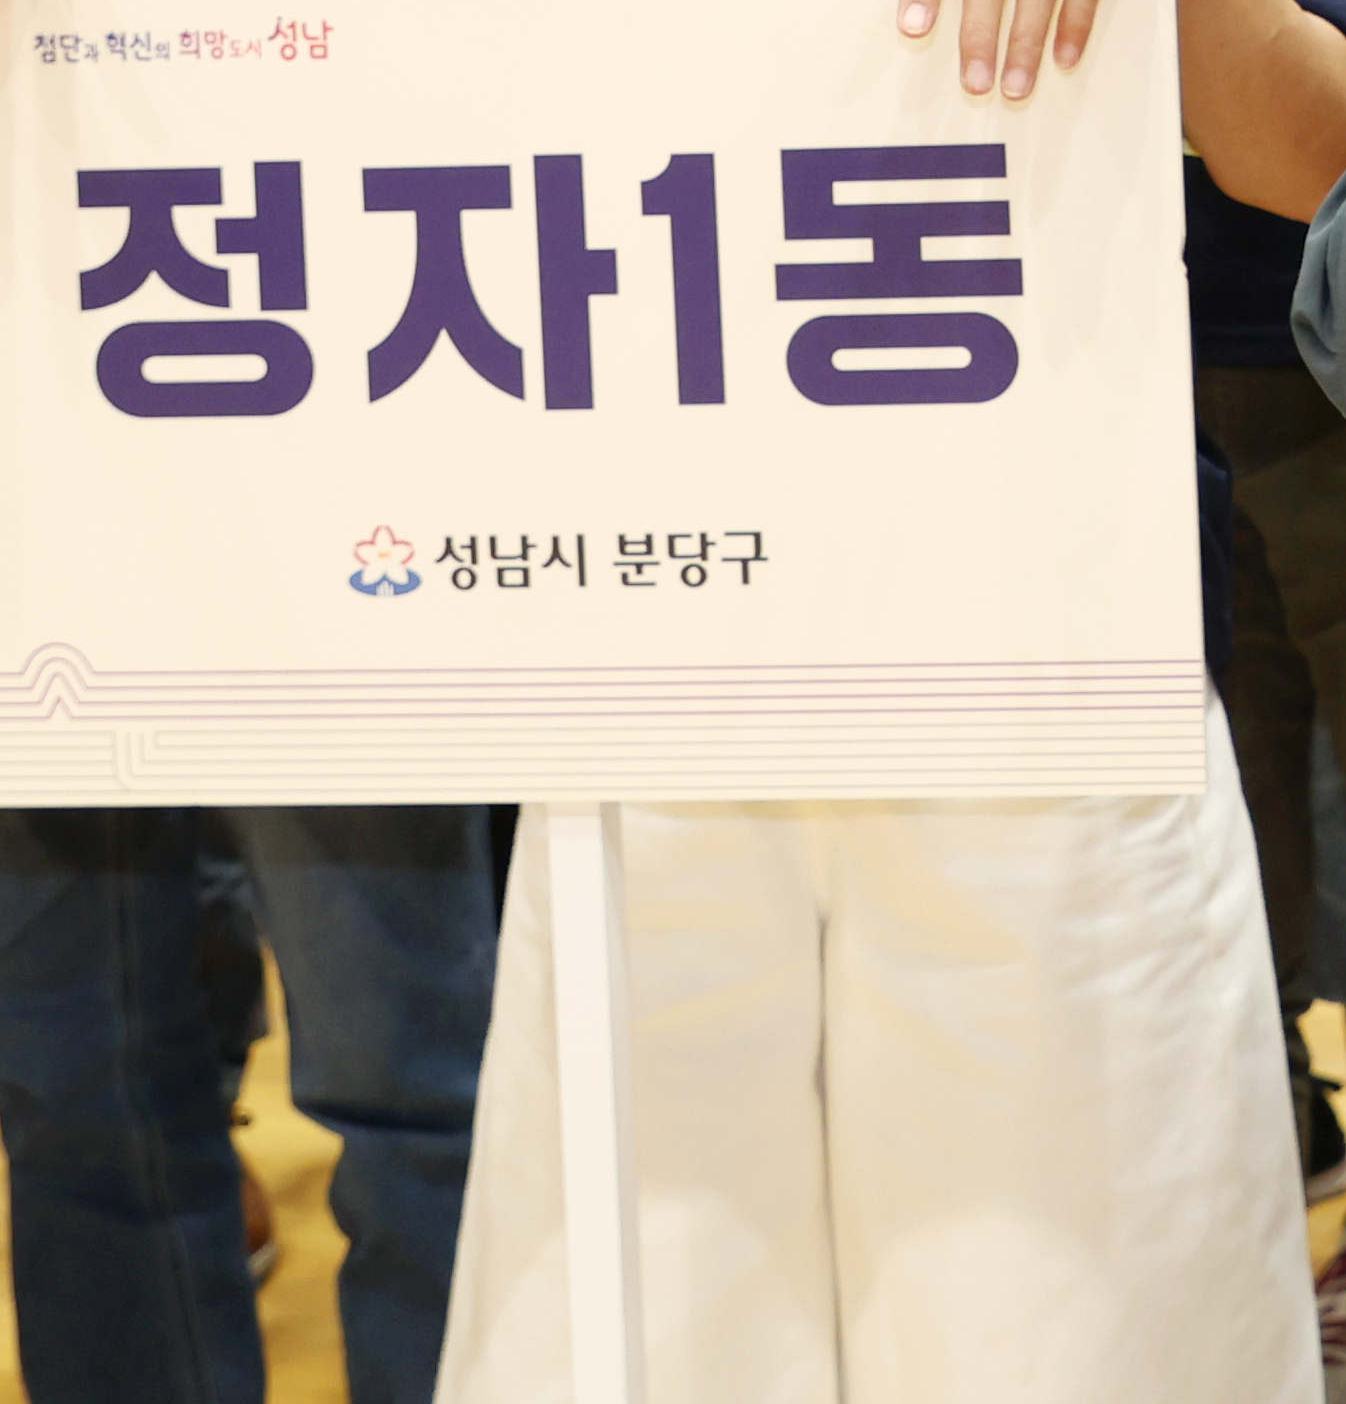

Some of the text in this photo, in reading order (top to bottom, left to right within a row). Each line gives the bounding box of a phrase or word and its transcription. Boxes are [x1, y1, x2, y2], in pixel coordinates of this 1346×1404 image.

[33, 16, 334, 64] 첨단과 혁신의 희망도시 성남
[75, 142, 1024, 419] 정자1동
[436, 531, 769, 590] 성남시 분당구
